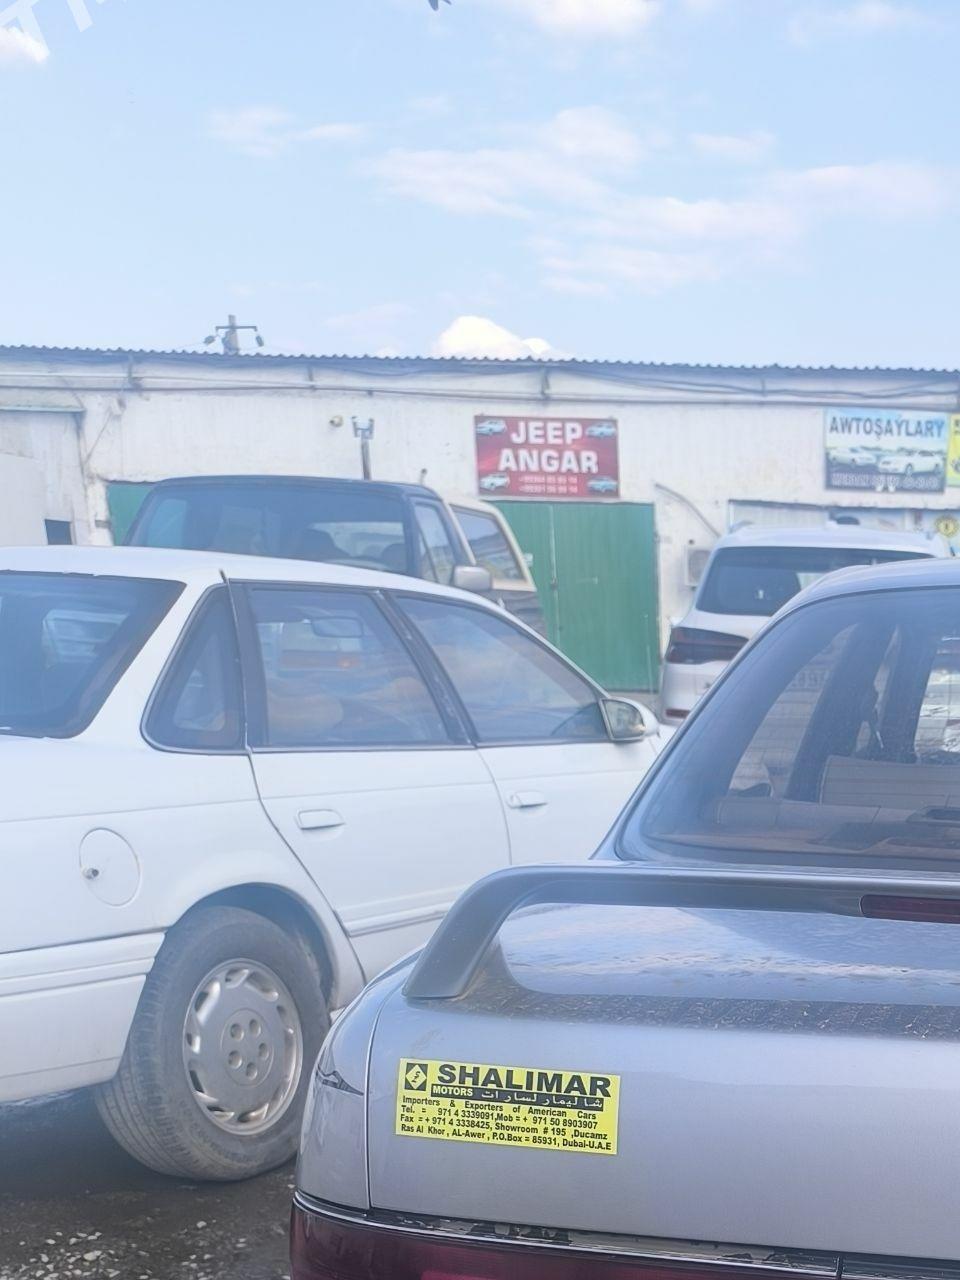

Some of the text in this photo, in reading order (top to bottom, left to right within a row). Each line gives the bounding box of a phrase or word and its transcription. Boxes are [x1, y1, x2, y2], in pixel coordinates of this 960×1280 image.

[510, 420, 583, 445] JEEP
[498, 447, 599, 474] ANGAR
[432, 1085, 474, 1096] MOTORS
[437, 1063, 611, 1098] SHALIMAR
[401, 1104, 415, 1113] Tel.
[437, 1107, 451, 1116] 971
[453, 1109, 459, 1117] 4
[532, 1116, 547, 1125] 971
[549, 1117, 560, 1126] 50
[562, 1118, 598, 1129] 8903907
[403, 1095, 440, 1106] Importers
[449, 1099, 456, 1107] &
[464, 1100, 503, 1112] Exporters
[528, 1106, 567, 1117] American
[577, 1110, 597, 1120] Cars
[400, 1113, 414, 1122] Fax
[432, 1116, 446, 1125] 971
[448, 1118, 454, 1126] 4
[495, 1122, 538, 1134] Showroom
[543, 1126, 549, 1134] #
[551, 1127, 566, 1137] 195
[401, 1123, 414, 1132] Ras
[416, 1125, 423, 1133] Al
[427, 1126, 445, 1135] Khor
